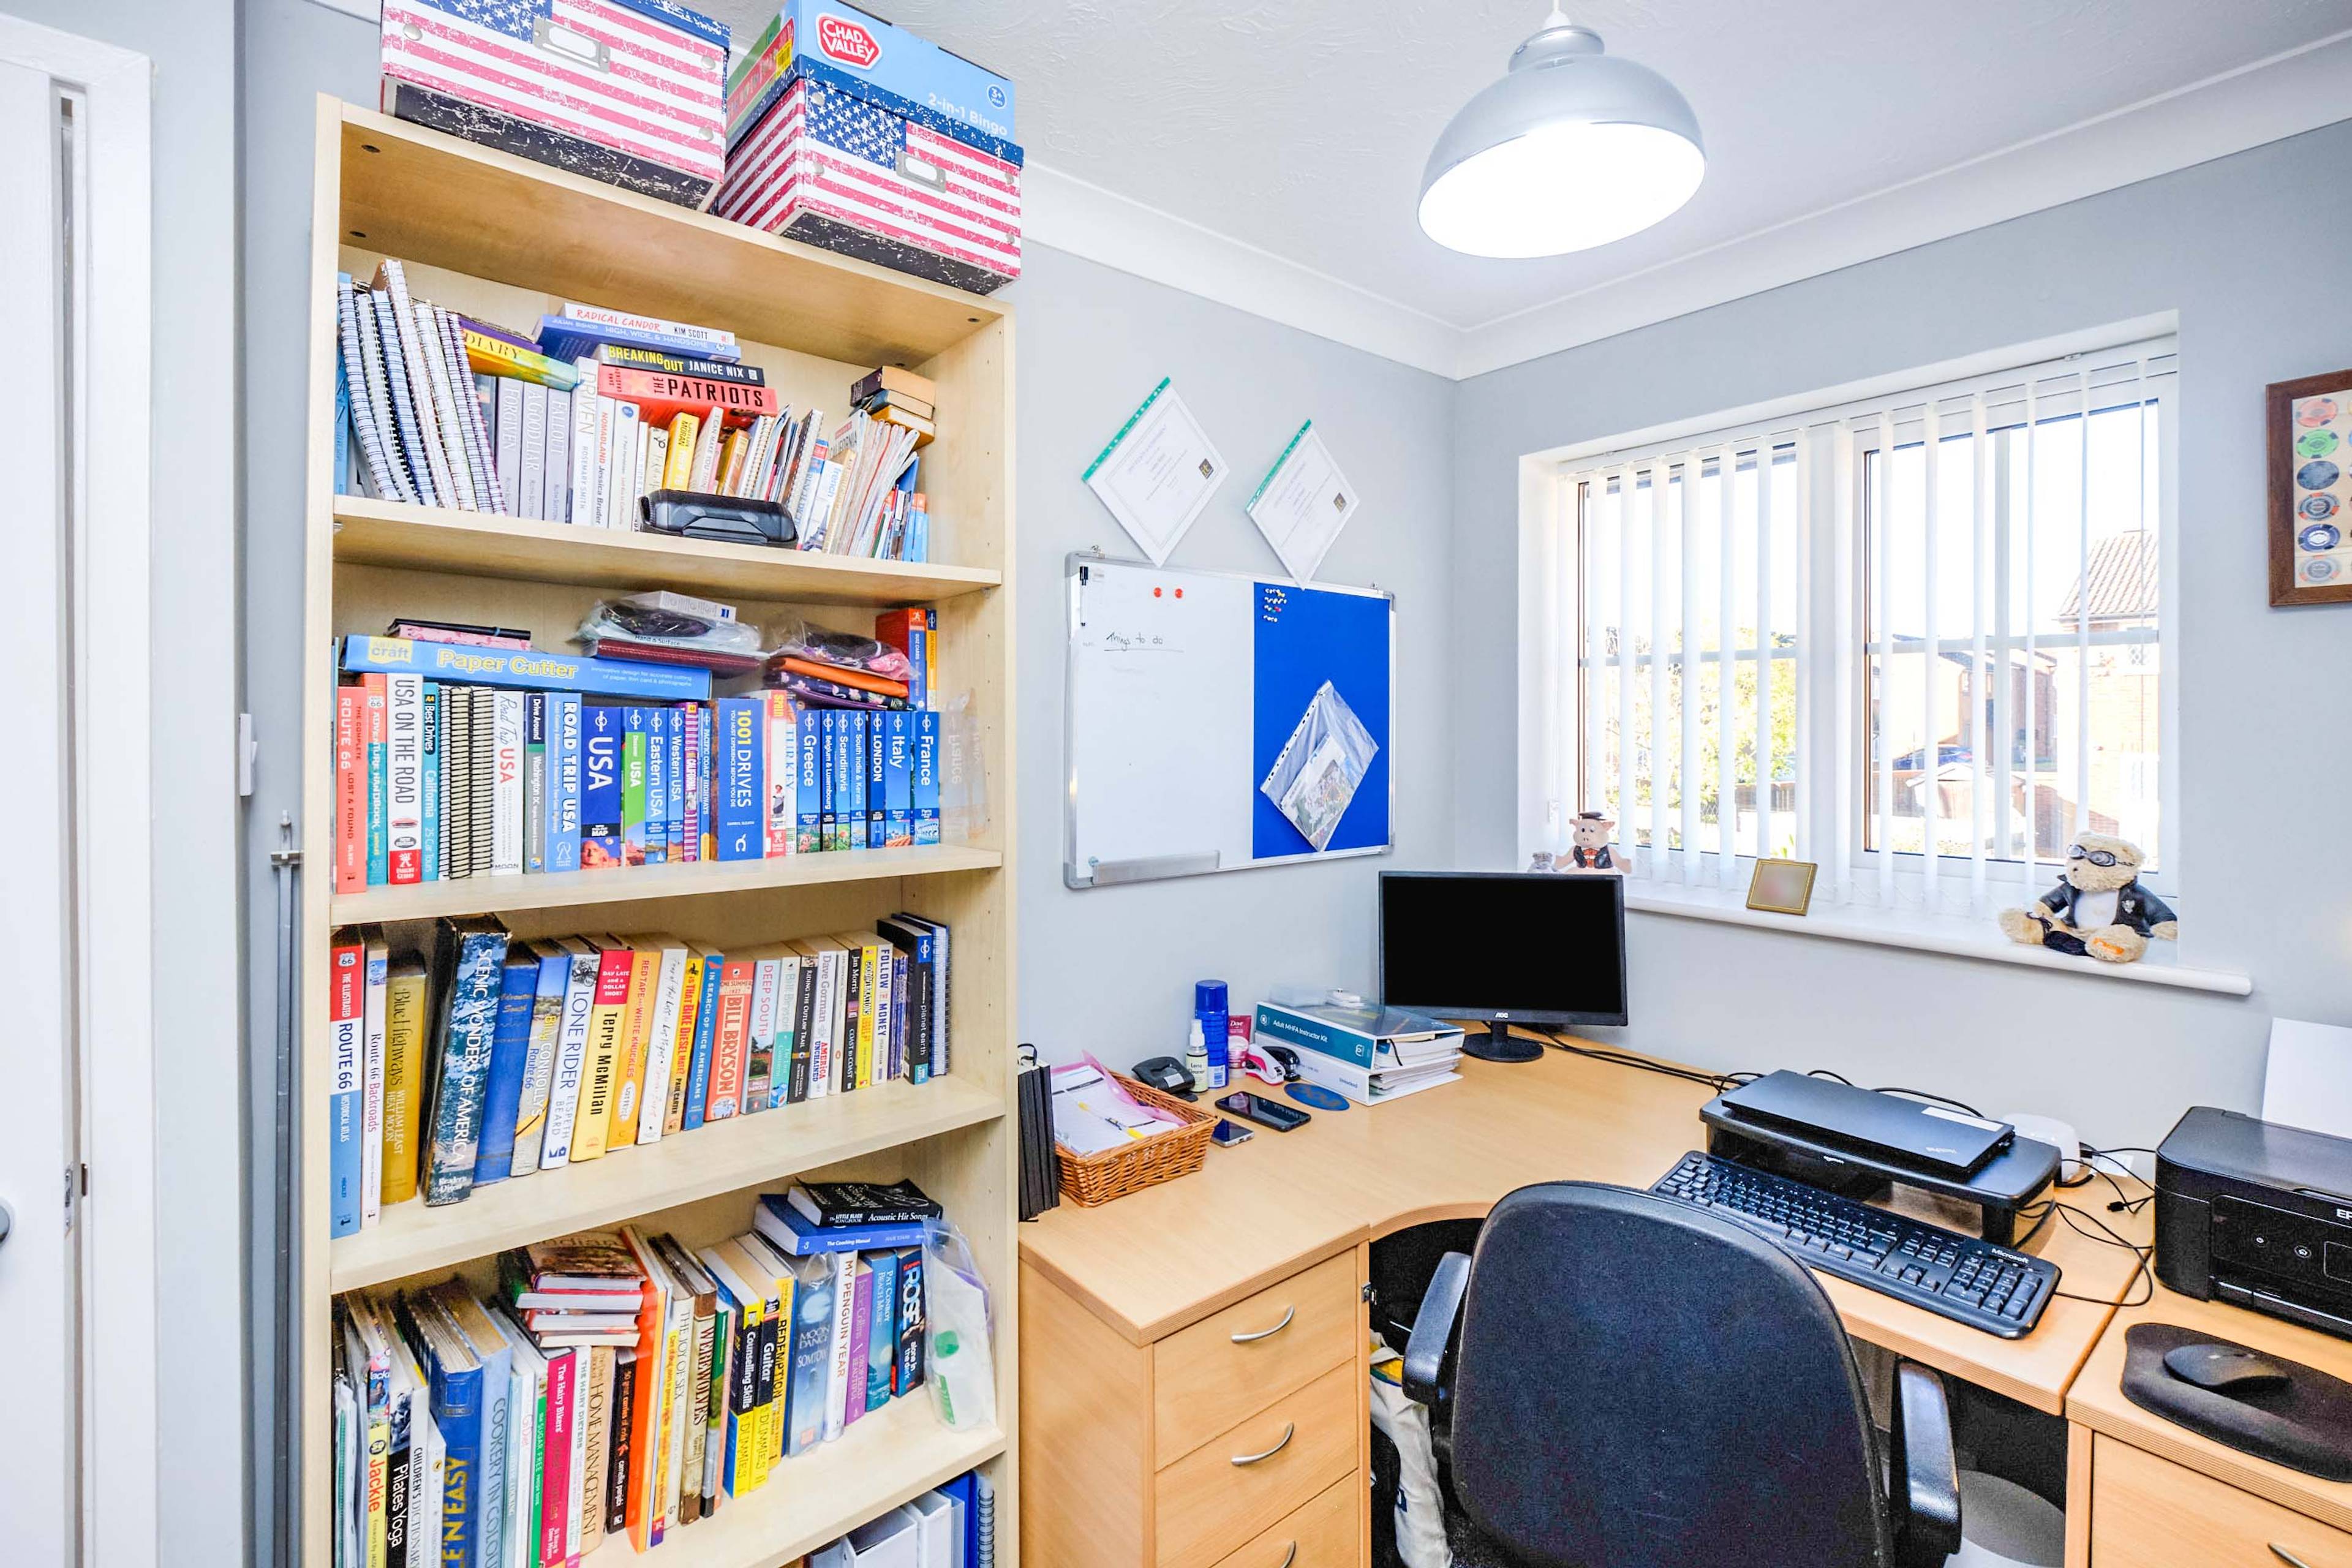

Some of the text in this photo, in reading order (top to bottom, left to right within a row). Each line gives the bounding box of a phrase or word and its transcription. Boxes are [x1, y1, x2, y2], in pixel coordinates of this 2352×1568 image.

[822, 32, 875, 62] VALLEY
[823, 20, 863, 43] CHAD
[466, 331, 521, 360] DIARY
[576, 309, 708, 340] RADICAL CANDOR KIM SCOTT
[608, 346, 744, 379] BREAKING OUT JANICE NIX
[653, 376, 665, 394] THE
[668, 377, 764, 407] PATRIOTS
[599, 412, 608, 463] NOMADLAND
[597, 466, 605, 496] Jessica
[372, 646, 409, 659] craft
[438, 650, 505, 671] Paper
[510, 657, 577, 677] Cutter
[1106, 631, 1163, 651] Things to do
[424, 705, 435, 752] Best Drives
[533, 698, 541, 716] Drive
[737, 710, 752, 745] 1001
[341, 698, 351, 769] ROUTE 66
[395, 680, 415, 804] USA ON THE ROAD
[889, 736, 905, 769] Italy
[562, 701, 577, 832] ROAD TRIP USA
[588, 737, 613, 791] USA
[650, 737, 663, 817] Eastern USA
[671, 736, 682, 802] Western USA
[737, 750, 752, 807] DRIVES
[804, 735, 817, 786] Greece
[840, 736, 848, 791] Scandinavia
[873, 735, 882, 782] LONDON
[921, 736, 933, 786] France
[425, 770, 437, 818] California
[851, 955, 860, 968] Jan
[880, 949, 889, 988] FOLLOW
[342, 973, 352, 1017] THE ILLUSTRATED
[705, 982, 714, 1014] SEARCH
[758, 965, 773, 1037] DEEP SOUTH
[819, 955, 831, 1022] Dave Gorman
[560, 992, 589, 1090] LONE RIDER
[627, 960, 650, 1078] RED TAPE WHITE KNUCKLES
[700, 1030, 709, 1049] NICE
[703, 1017, 710, 1028] OF
[878, 1003, 888, 1036] MONEY
[1273, 1020, 1284, 1029] Adult
[1284, 1023, 1298, 1034] MHFA
[1298, 1027, 1319, 1040] Instructor
[338, 1023, 353, 1090] ROUTE 66
[370, 1033, 381, 1064] Route
[451, 949, 492, 1164] SCENIC WONDERS OF AMERICA
[590, 1011, 618, 1115] Terry McMillan
[719, 997, 743, 1092] BILL BRYSON
[812, 1041, 821, 1082] UNCHAINED
[369, 1068, 380, 1080] 66
[525, 1048, 539, 1090] Route 66
[694, 1052, 707, 1099] AMERICANS
[368, 1083, 380, 1132] Backroads
[386, 1091, 396, 1141] HEAT MOON
[394, 1090, 405, 1154] WILLIAM LEAST
[552, 1101, 565, 1136] BEARD
[562, 1095, 576, 1139] ELSPETH
[671, 1093, 680, 1115] CARTER
[868, 1213, 896, 1222] Acoustic
[910, 1212, 928, 1222] Songs
[1992, 1248, 2029, 1264] Microsoft
[837, 1260, 853, 1378] MY PENGUIN YEAR
[884, 1288, 892, 1322] CONROY
[903, 1267, 921, 1330] ROSE
[673, 1311, 690, 1400] THE JOY OF SEX
[910, 1341, 918, 1362] alone
[555, 1364, 567, 1433] The Hairy Bikers'
[578, 1378, 586, 1409] HAIRY
[693, 1326, 714, 1426] WEREWOLVES
[737, 1332, 756, 1478] Counselling Skills DUMMIES
[756, 1343, 774, 1469] Guitar DUMMIES
[583, 1382, 603, 1537] HOME MANAGEMENT
[388, 1463, 408, 1547] Pilates Yoga
